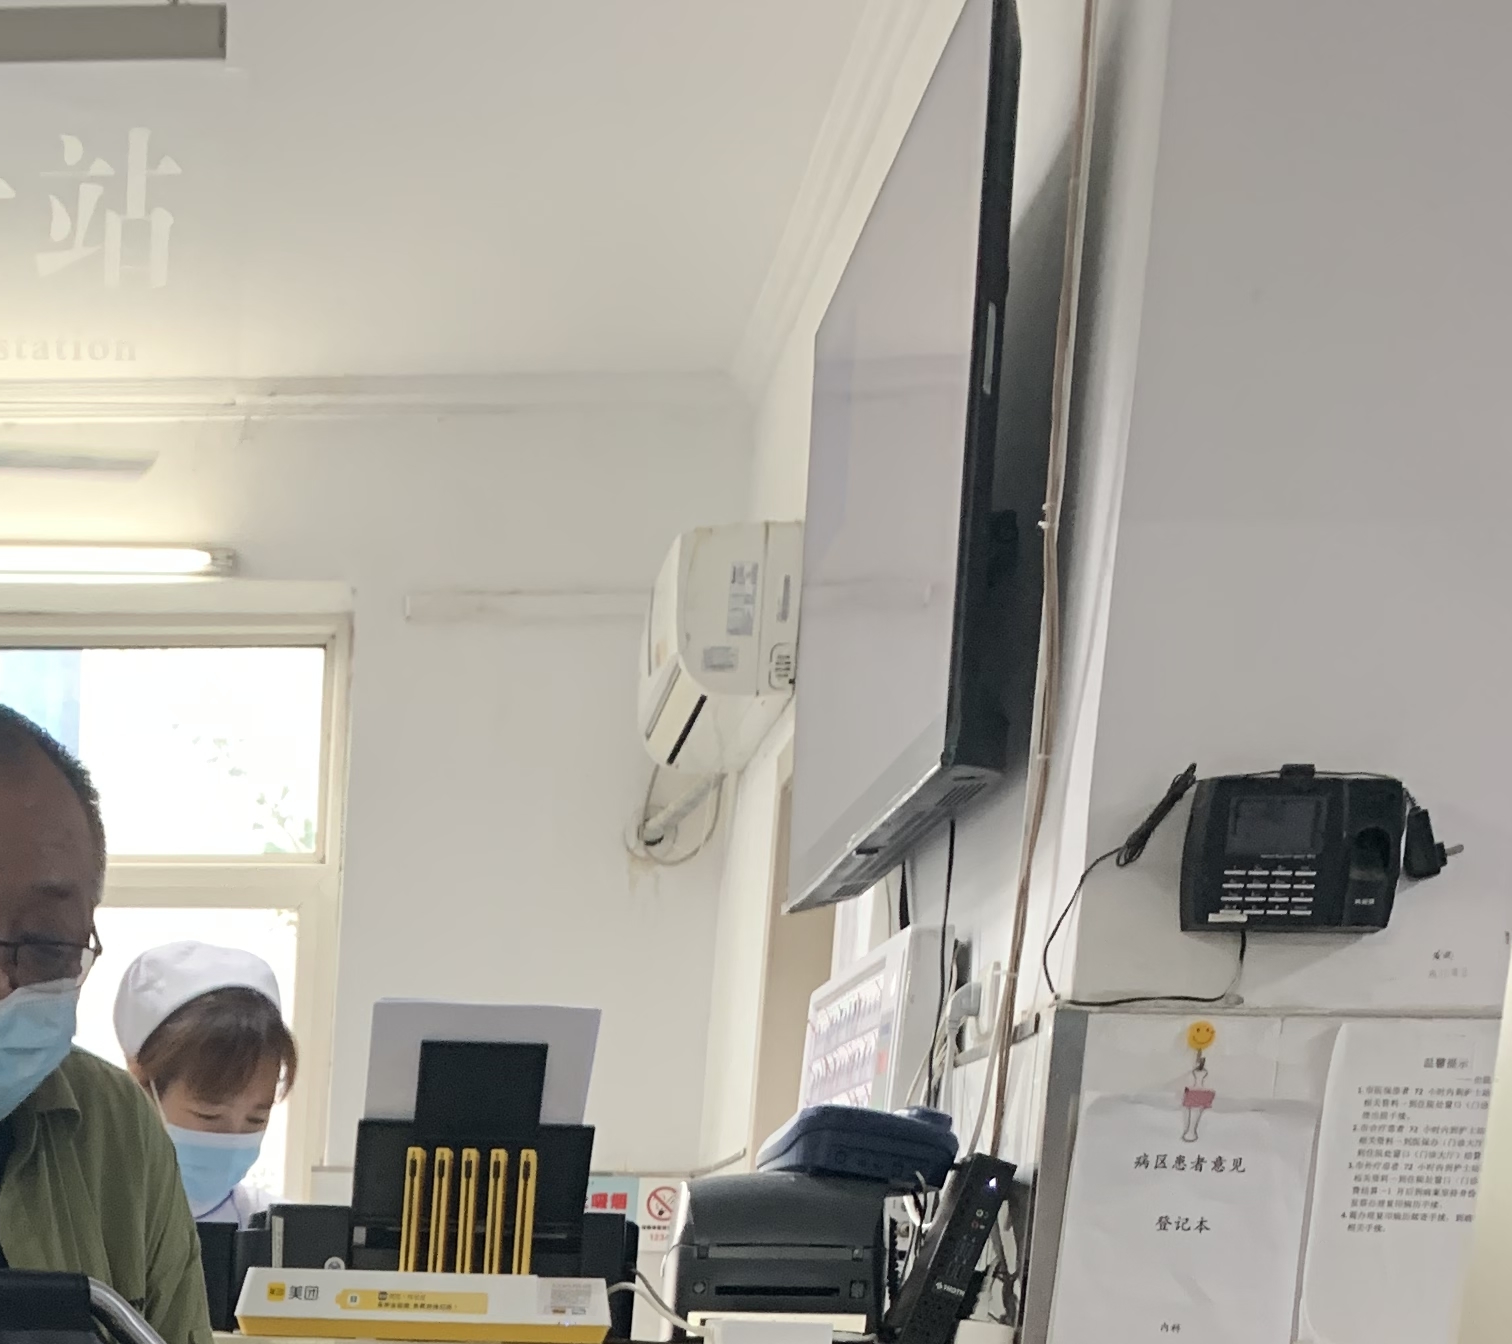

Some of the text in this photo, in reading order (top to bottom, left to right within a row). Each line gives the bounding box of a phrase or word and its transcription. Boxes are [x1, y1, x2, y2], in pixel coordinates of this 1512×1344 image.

[1134, 1151, 1248, 1175] 病区患者意见
[1155, 1214, 1211, 1235] 登记本
[288, 1285, 319, 1301] 美团
